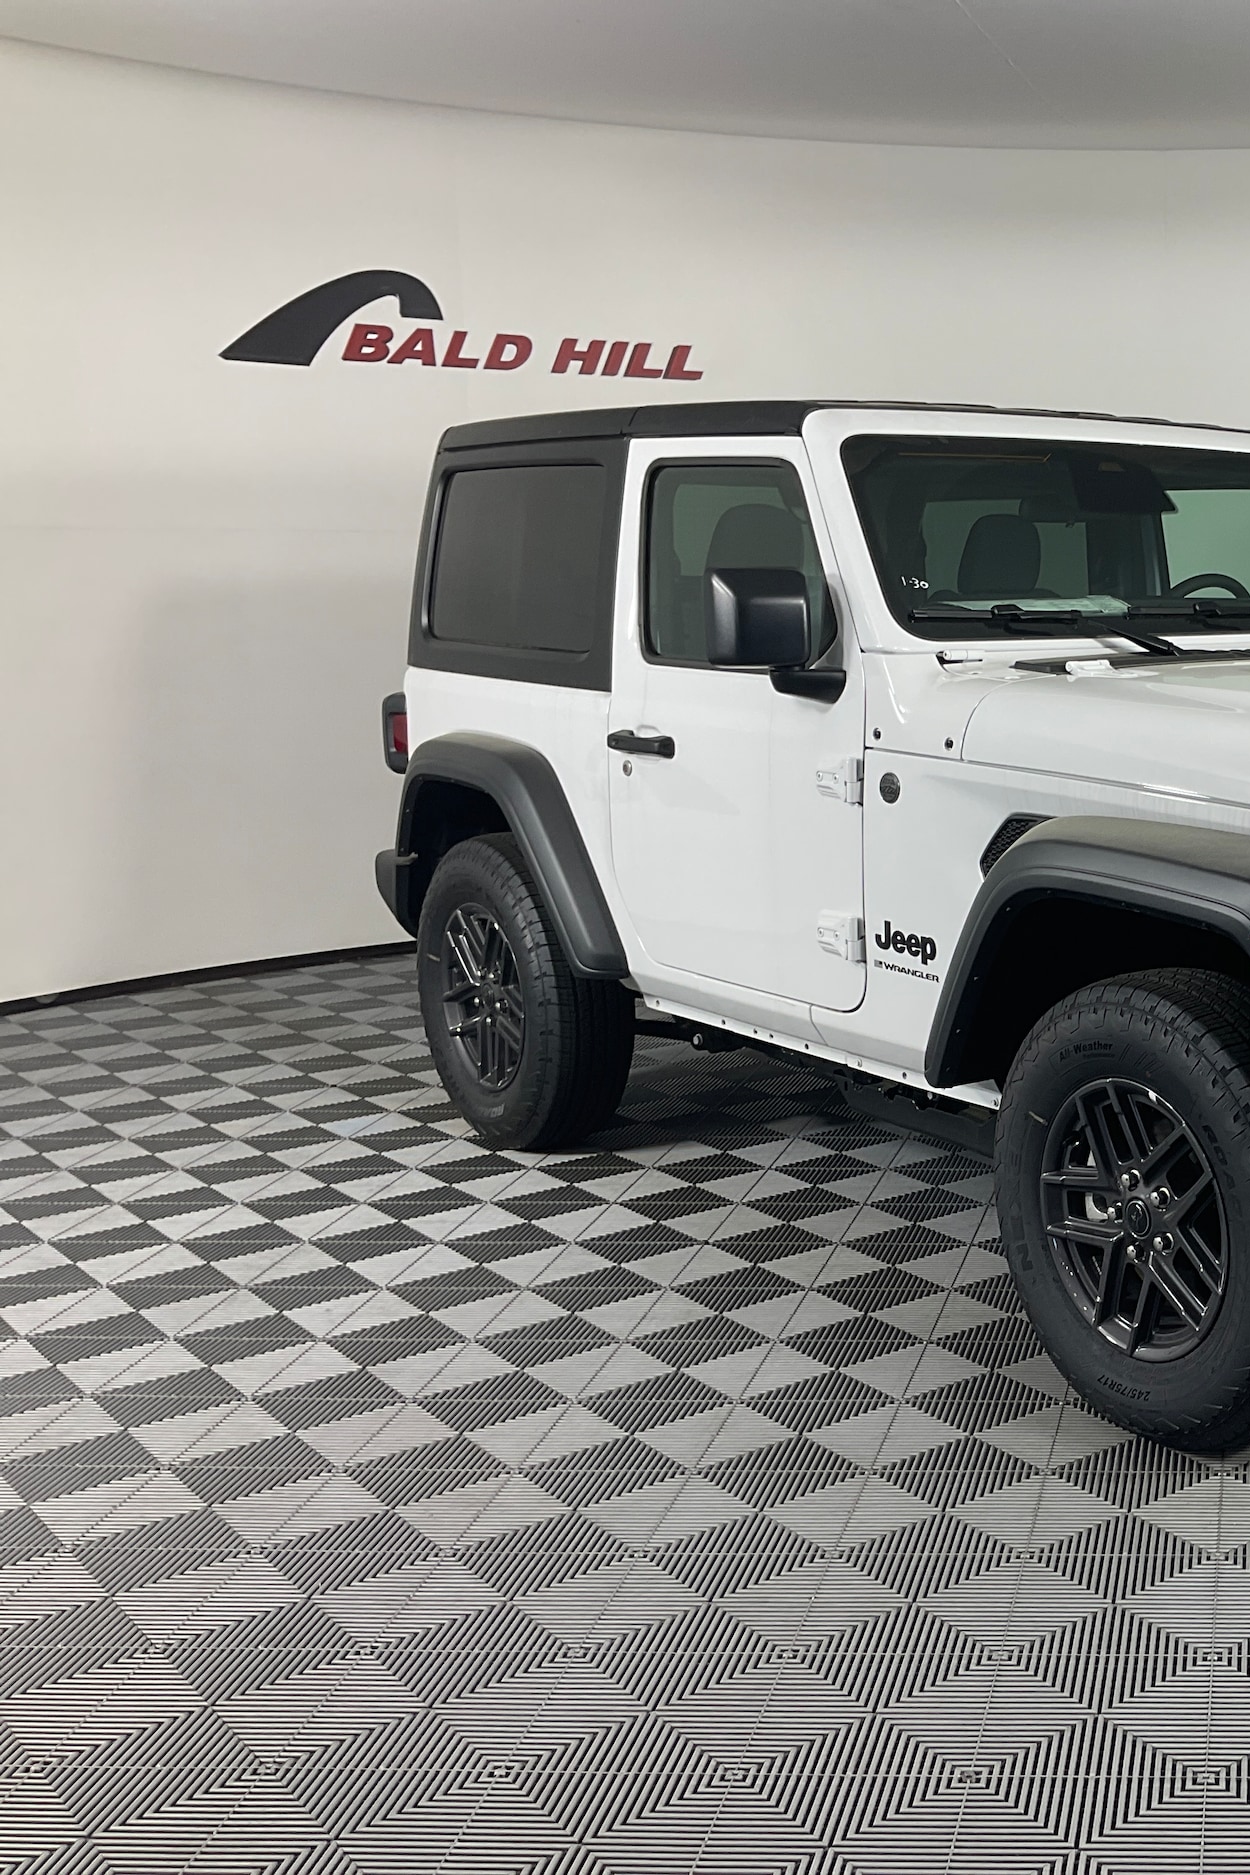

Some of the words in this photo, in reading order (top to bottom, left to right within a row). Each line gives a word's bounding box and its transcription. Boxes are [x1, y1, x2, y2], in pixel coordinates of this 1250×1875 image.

[341, 323, 533, 371] BALD
[550, 337, 704, 380] HILL
[900, 575, 930, 590] 1-30
[874, 919, 937, 966] Jeep
[883, 960, 940, 984] WRANGLER
[1058, 1040, 1114, 1063] All-Weather
[1096, 1373, 1152, 1402] 245/75R17
